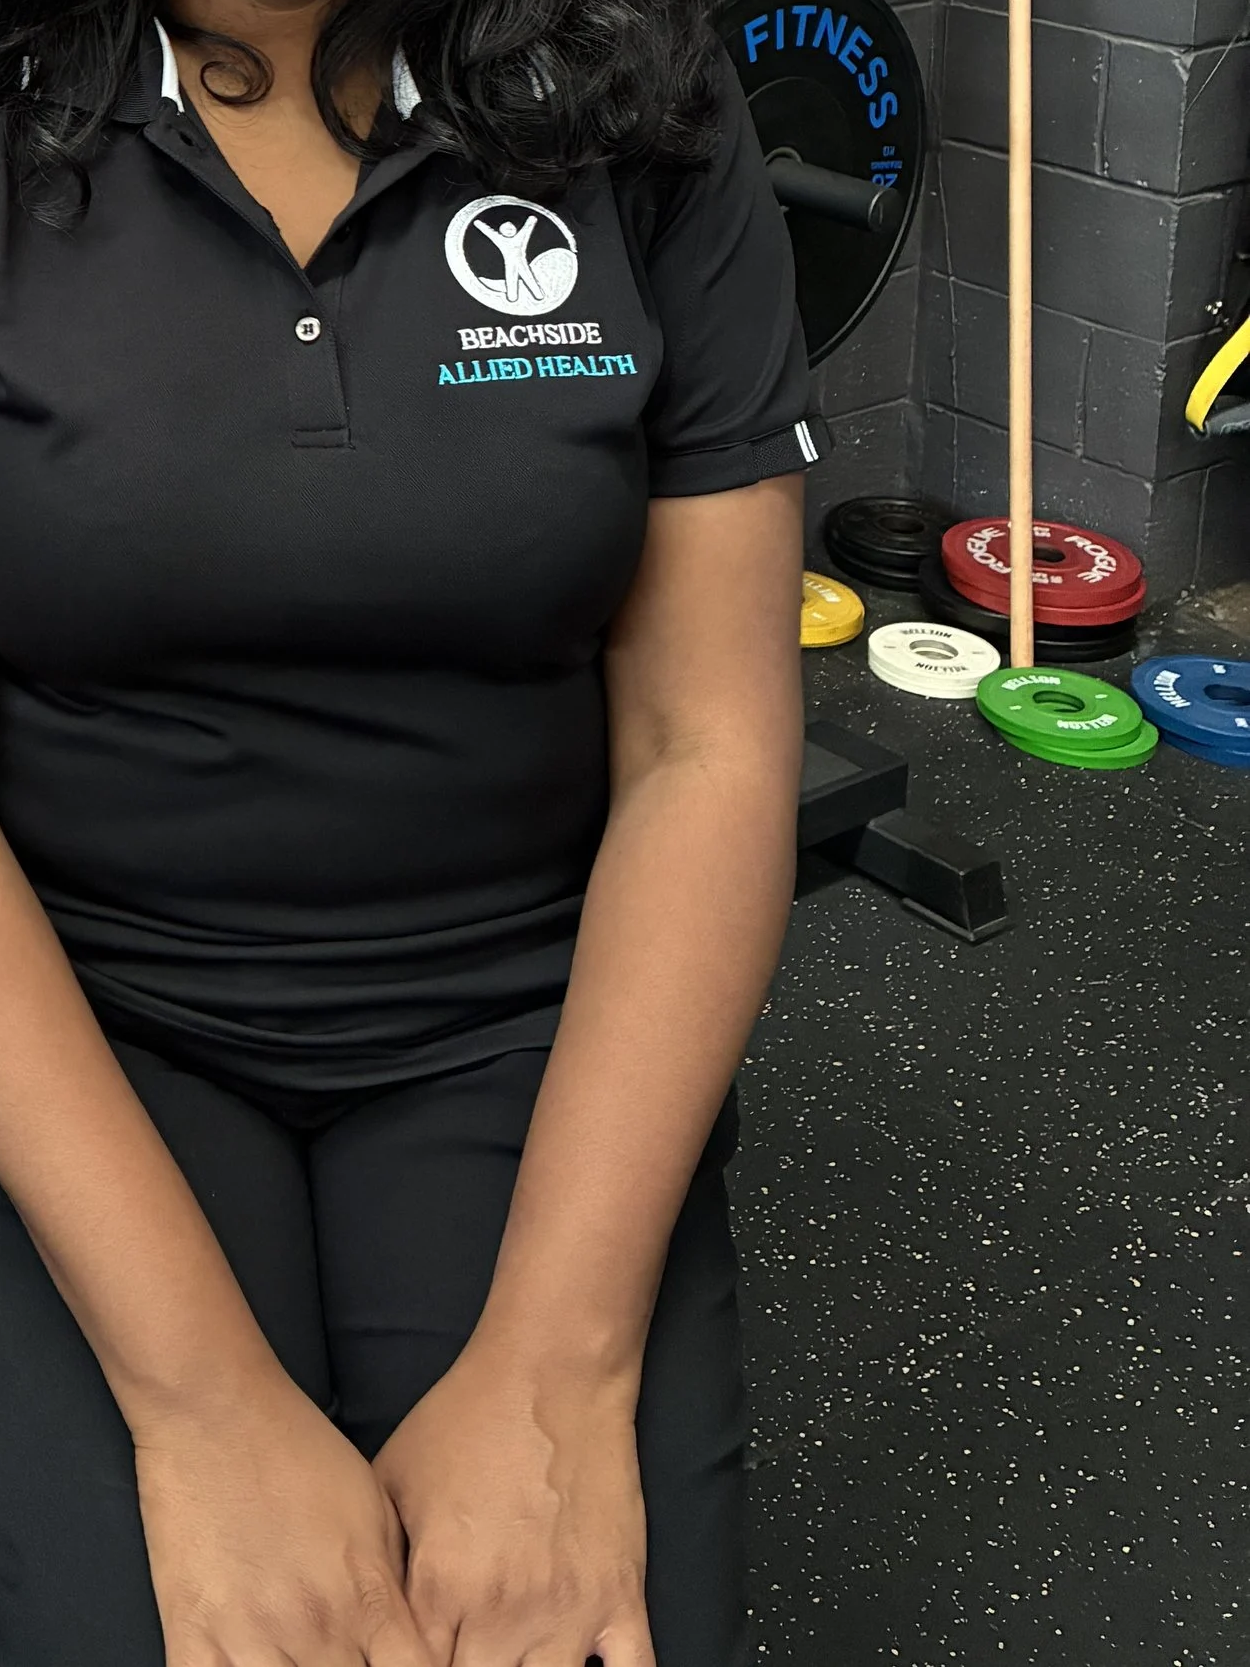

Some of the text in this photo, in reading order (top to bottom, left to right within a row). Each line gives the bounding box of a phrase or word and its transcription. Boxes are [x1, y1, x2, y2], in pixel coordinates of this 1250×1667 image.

[744, 6, 897, 128] FITNESS
[457, 323, 602, 350] BEACHSIDE
[438, 354, 638, 386] ALLIED HEALTH
[1064, 535, 1117, 583] ROGUE
